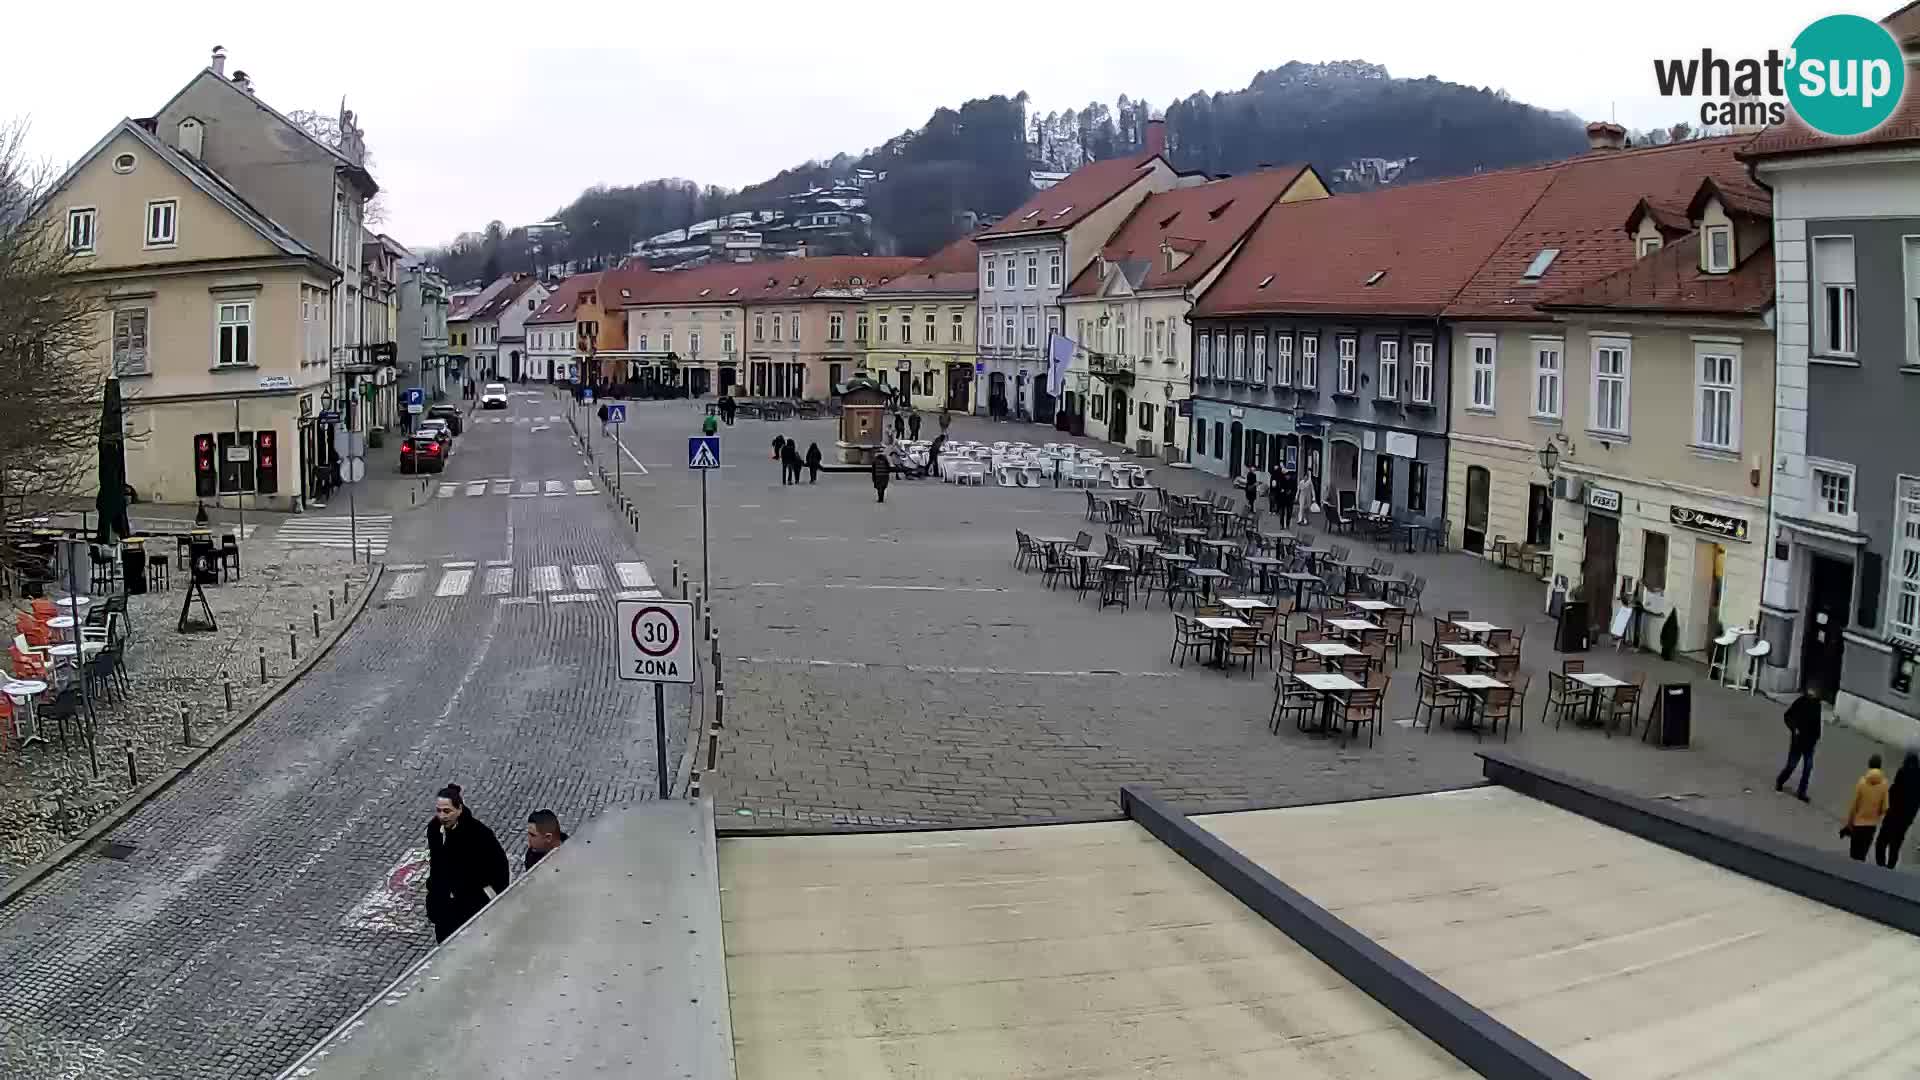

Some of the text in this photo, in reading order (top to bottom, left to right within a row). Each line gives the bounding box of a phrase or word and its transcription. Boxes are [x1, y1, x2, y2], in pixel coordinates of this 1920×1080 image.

[411, 391, 420, 403] P
[643, 622, 668, 643] 30
[634, 659, 678, 677] ZONA
